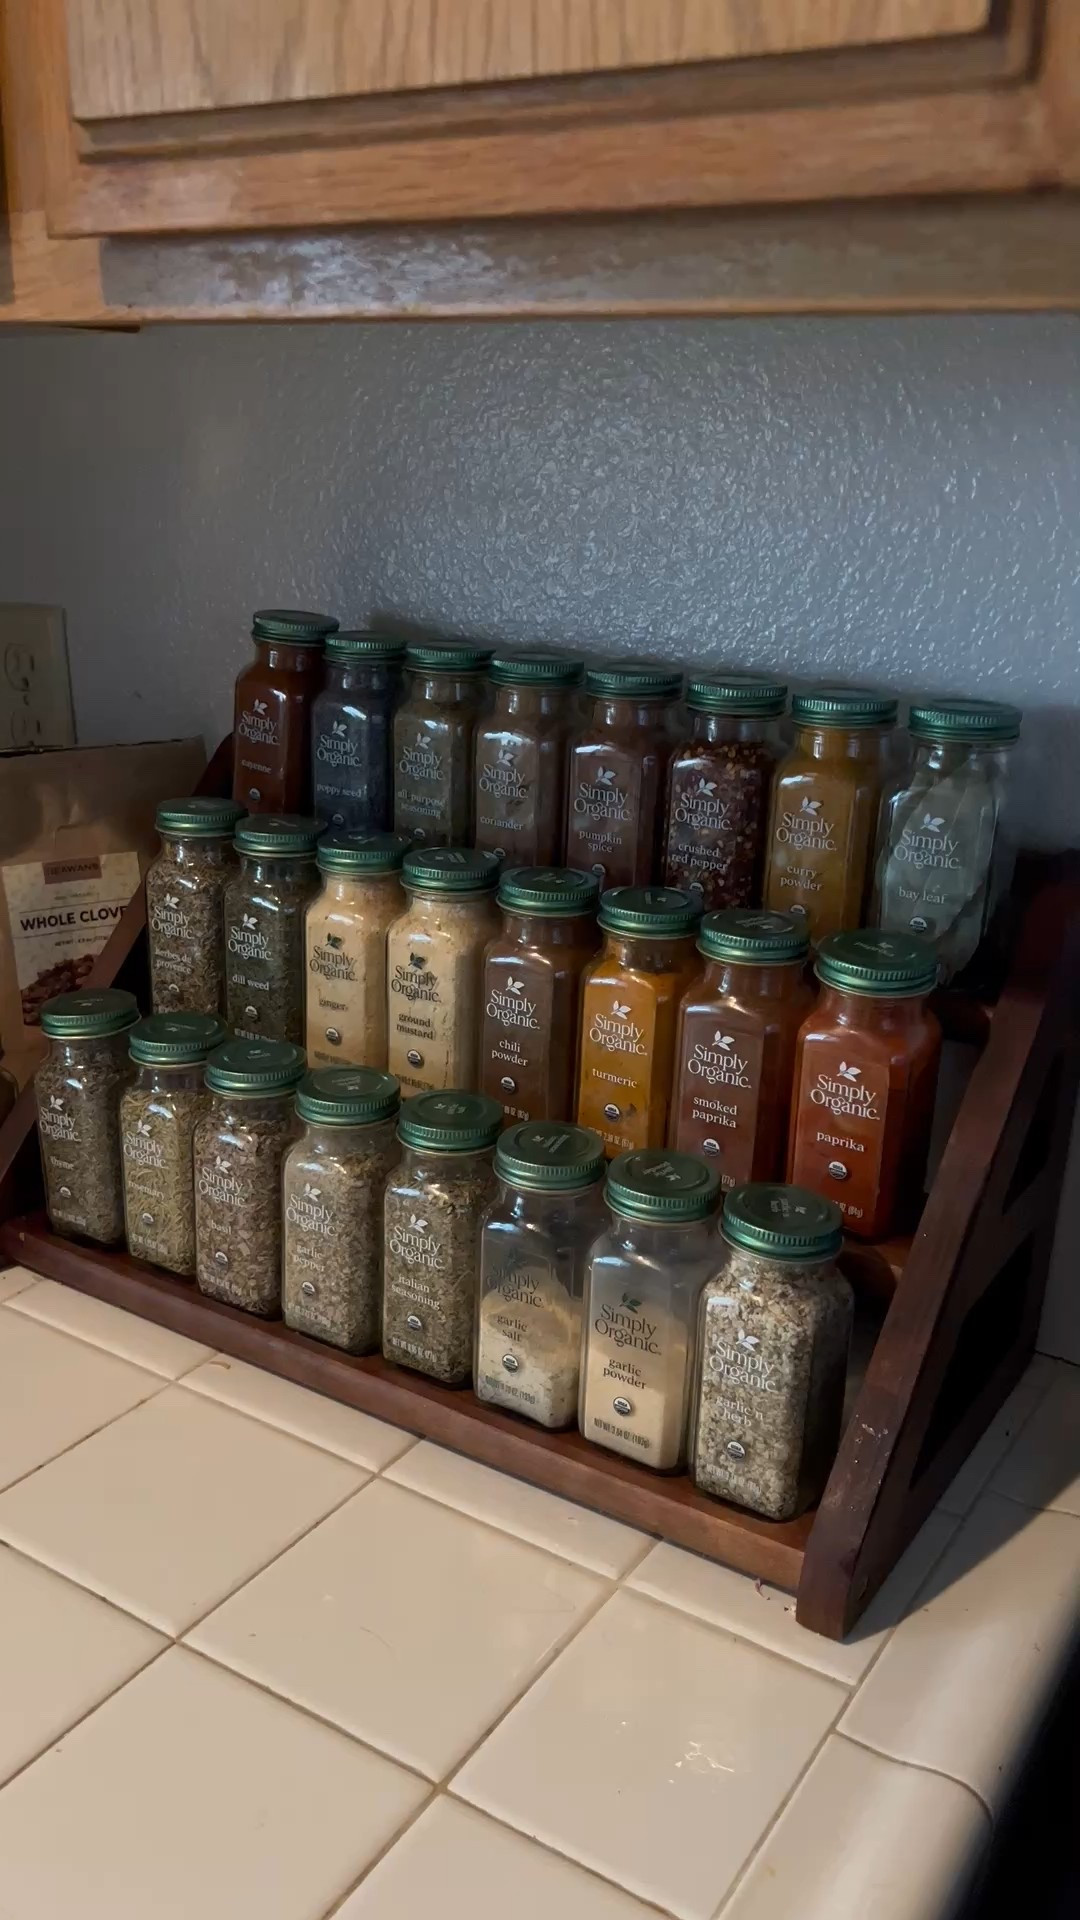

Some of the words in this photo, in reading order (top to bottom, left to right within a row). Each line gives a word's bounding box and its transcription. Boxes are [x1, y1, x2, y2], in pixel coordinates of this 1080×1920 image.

[239, 722, 279, 745] Organic
[242, 710, 277, 735] Simply
[320, 734, 358, 756] Simply
[241, 759, 272, 774] cayenne
[317, 747, 360, 767] Organic
[403, 746, 442, 769] Simply
[399, 759, 445, 781] Organic
[483, 763, 525, 787] Simply
[316, 783, 340, 797] poppy
[342, 787, 361, 798] seed
[479, 778, 527, 799] Organic
[579, 782, 628, 808] Simply
[574, 798, 630, 821] Organic
[680, 793, 730, 818] Simply
[480, 815, 524, 831] coriander
[675, 808, 730, 830] Organic
[782, 811, 834, 838] Simply
[579, 829, 622, 845] pumpkin
[587, 840, 613, 854] spice
[776, 826, 835, 850] Organic
[900, 828, 959, 856] Simply
[671, 853, 688, 865] red
[690, 855, 728, 871] pepper
[678, 843, 720, 859] crushed
[894, 844, 961, 870] Organic
[780, 875, 822, 892] powder
[786, 865, 817, 880] curry
[898, 886, 918, 902] bay
[922, 890, 947, 905] leaf
[20, 912, 77, 931] WHOLE
[153, 905, 191, 927] Simply
[151, 917, 192, 939] Organic
[230, 925, 269, 949] Simply
[228, 939, 272, 961] Organic
[313, 945, 354, 967] Simply
[156, 959, 192, 974] provence
[309, 958, 355, 981] Organic
[395, 965, 438, 988] Simply
[232, 973, 245, 985] dill
[247, 979, 270, 991] weed
[391, 979, 439, 1003] Organic
[319, 998, 347, 1011] ginger
[491, 988, 536, 1017] Simply
[398, 1012, 431, 1027] ground
[486, 1002, 538, 1028] Organic
[396, 1023, 434, 1040] mustard
[594, 1013, 644, 1043] Simply
[499, 1039, 521, 1053] chili
[589, 1027, 645, 1055] Organic
[491, 1049, 529, 1067] powder
[693, 1044, 748, 1075] Simply
[591, 1068, 638, 1088] turmeric
[687, 1058, 749, 1087] Organic
[816, 1073, 876, 1106] Simply
[693, 1096, 738, 1116] smoked
[810, 1088, 878, 1120] Organic
[40, 1107, 76, 1130] Simply
[692, 1108, 737, 1128] paprika
[39, 1119, 79, 1142] Organic
[126, 1130, 164, 1155] Simply
[816, 1131, 865, 1153] paprika
[123, 1142, 167, 1169] Organic
[128, 1180, 165, 1200] rosemary
[201, 1166, 243, 1194] Simply
[198, 1179, 246, 1207] Organic
[290, 1193, 334, 1224] Simply
[210, 1219, 232, 1235] basil
[286, 1206, 337, 1236] Organic
[394, 1225, 441, 1256] Simply
[297, 1244, 323, 1260] garlic
[389, 1238, 445, 1269] Organic
[294, 1254, 326, 1273] pepper
[399, 1273, 430, 1293] italian
[391, 1283, 441, 1311] seasoning
[497, 1314, 529, 1333] garlic
[600, 1303, 657, 1340] Simply
[502, 1328, 522, 1342] salt
[594, 1318, 660, 1355] Organic
[608, 1358, 642, 1378] garlic
[715, 1340, 775, 1379] Simply
[603, 1366, 647, 1390] powder
[709, 1354, 776, 1393] Organic
[716, 1396, 752, 1416] garlic
[723, 1408, 752, 1427] herb
